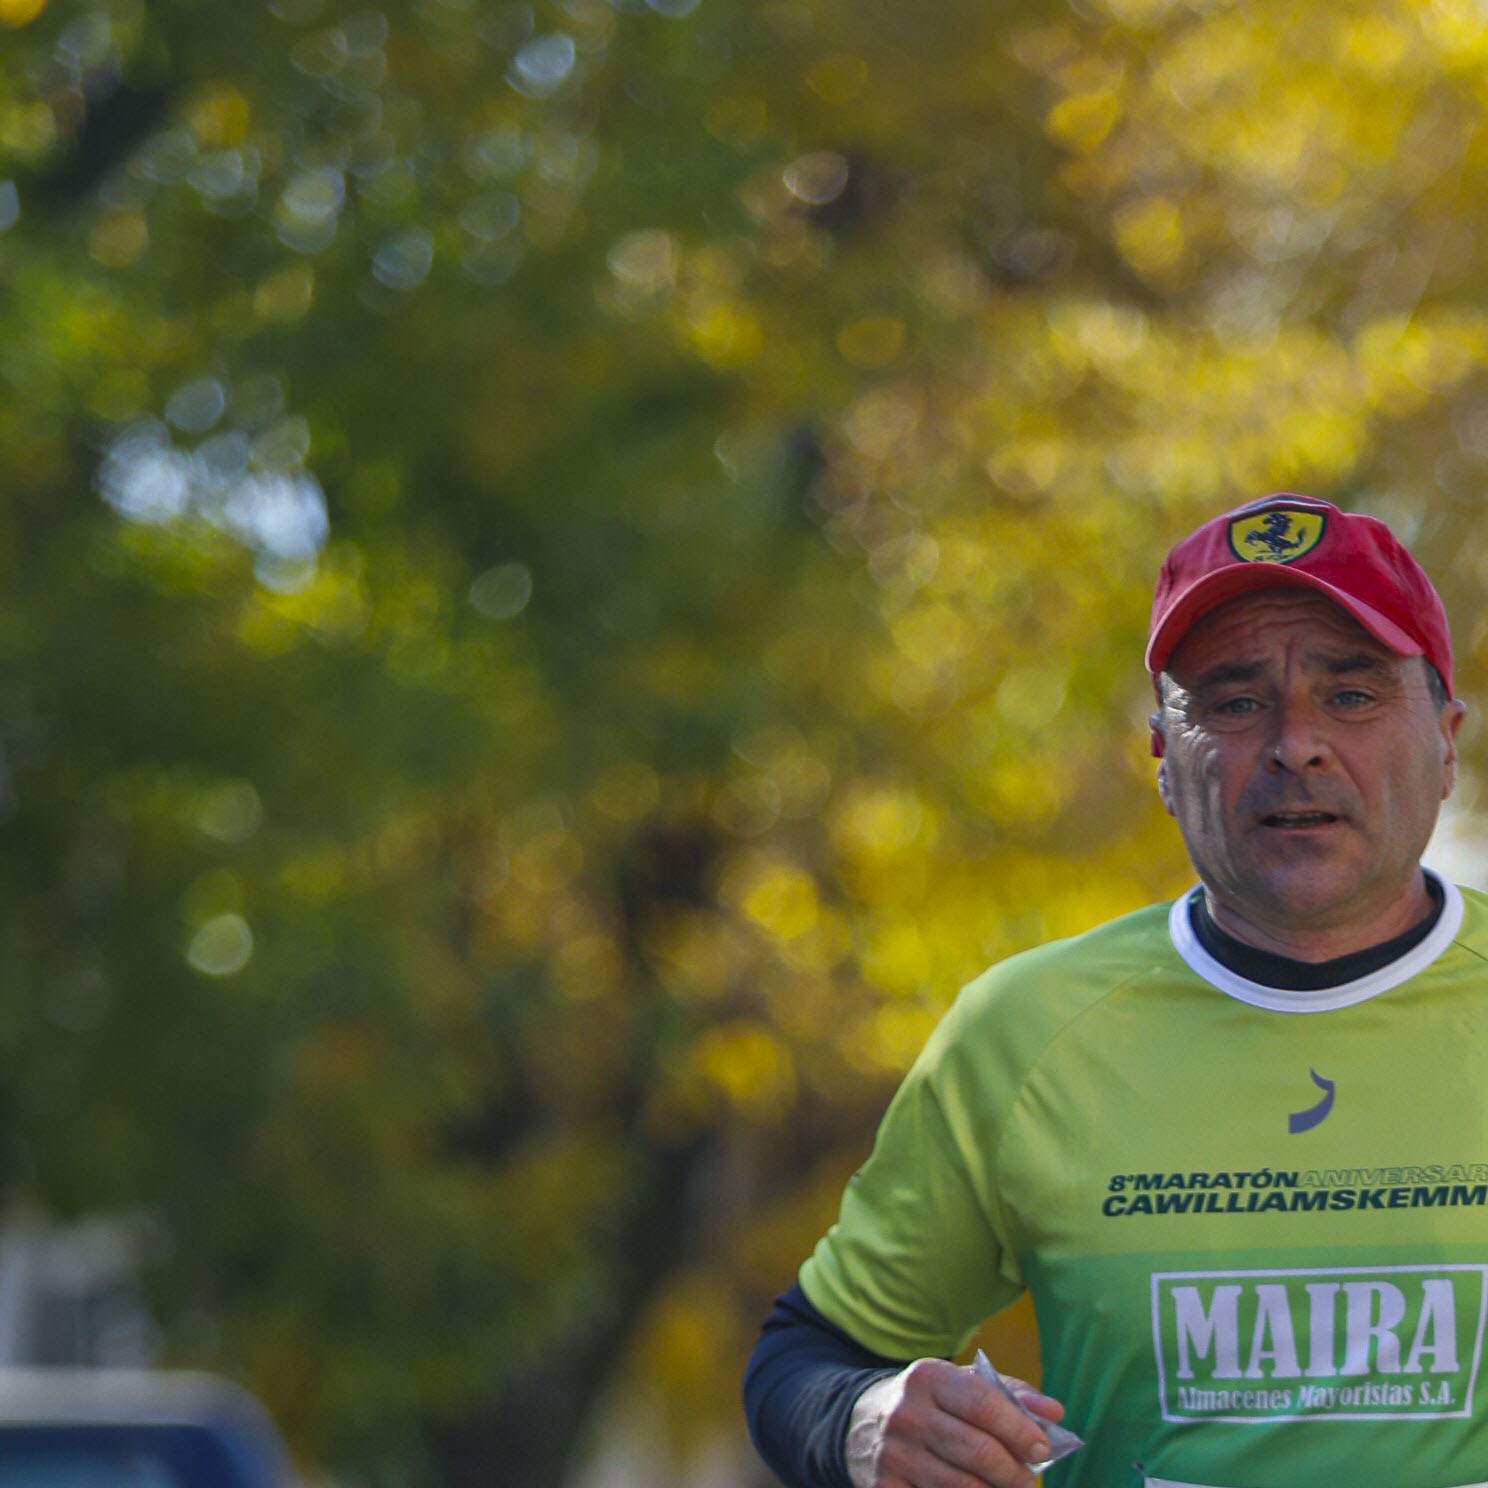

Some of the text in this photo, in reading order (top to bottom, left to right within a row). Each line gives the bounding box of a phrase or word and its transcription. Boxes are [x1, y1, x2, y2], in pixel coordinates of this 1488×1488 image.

[1171, 1279, 1460, 1379] MAIRA
[1177, 1380, 1456, 1410] Almacenes Mayoristas S.A.
